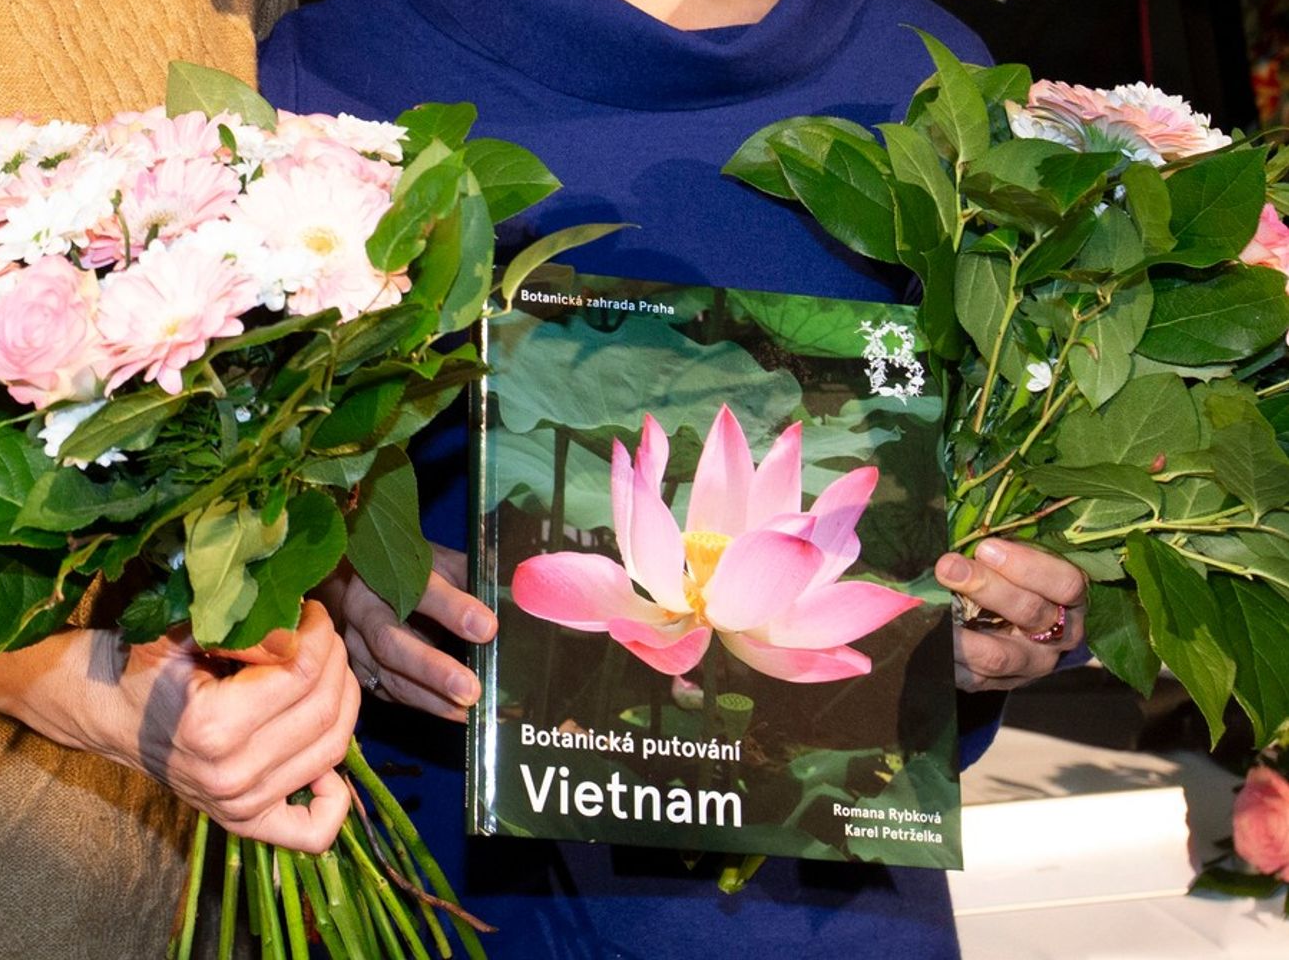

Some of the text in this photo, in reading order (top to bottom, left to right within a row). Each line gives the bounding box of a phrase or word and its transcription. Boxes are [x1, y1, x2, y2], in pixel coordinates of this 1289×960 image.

[520, 289, 675, 315] Botanická zahrada Praha
[521, 723, 742, 761] Botanická putování
[519, 763, 743, 828] Vietnam
[833, 803, 942, 824] Romana Rybková
[844, 823, 942, 844] Karel Petrželka
